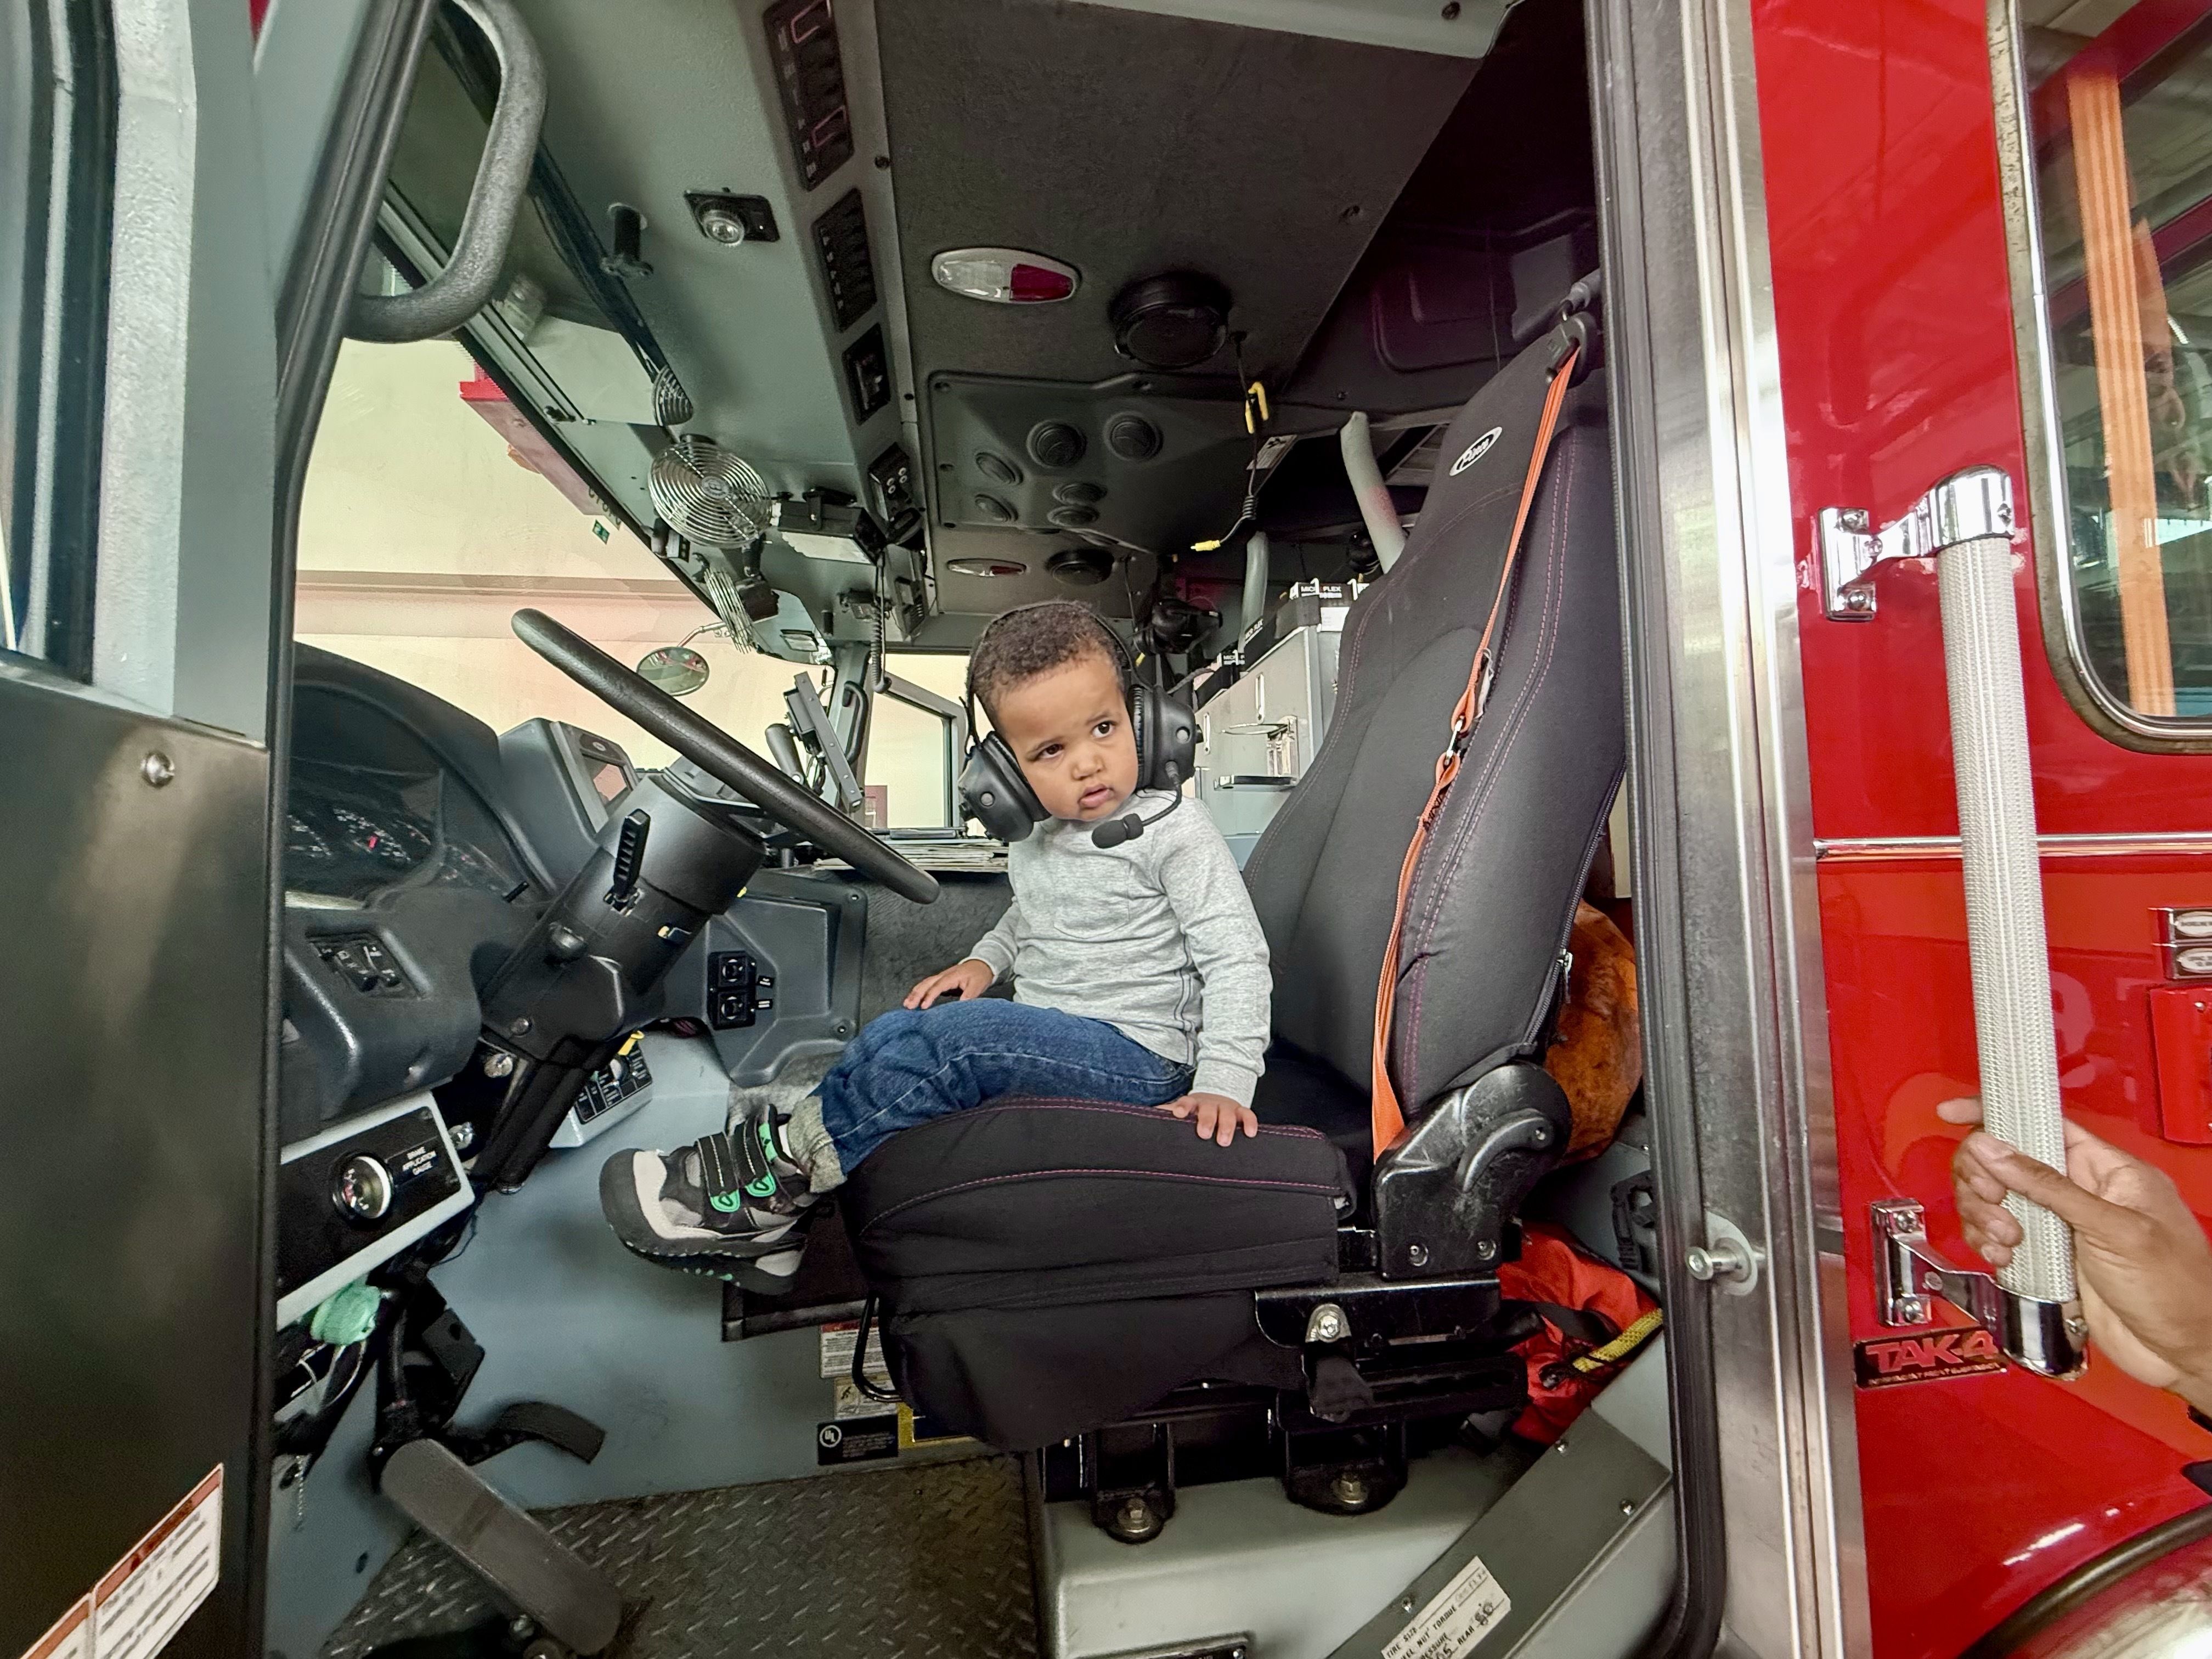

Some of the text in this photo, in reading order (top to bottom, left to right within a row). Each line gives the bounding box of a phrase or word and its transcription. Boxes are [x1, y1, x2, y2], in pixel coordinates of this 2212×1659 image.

[1866, 1330, 1999, 1374] TAK-4
[1432, 1605, 1457, 1630] TORQUE
[1403, 1627, 1418, 1643] SIZE
[1457, 1625, 1475, 1645] REAR
